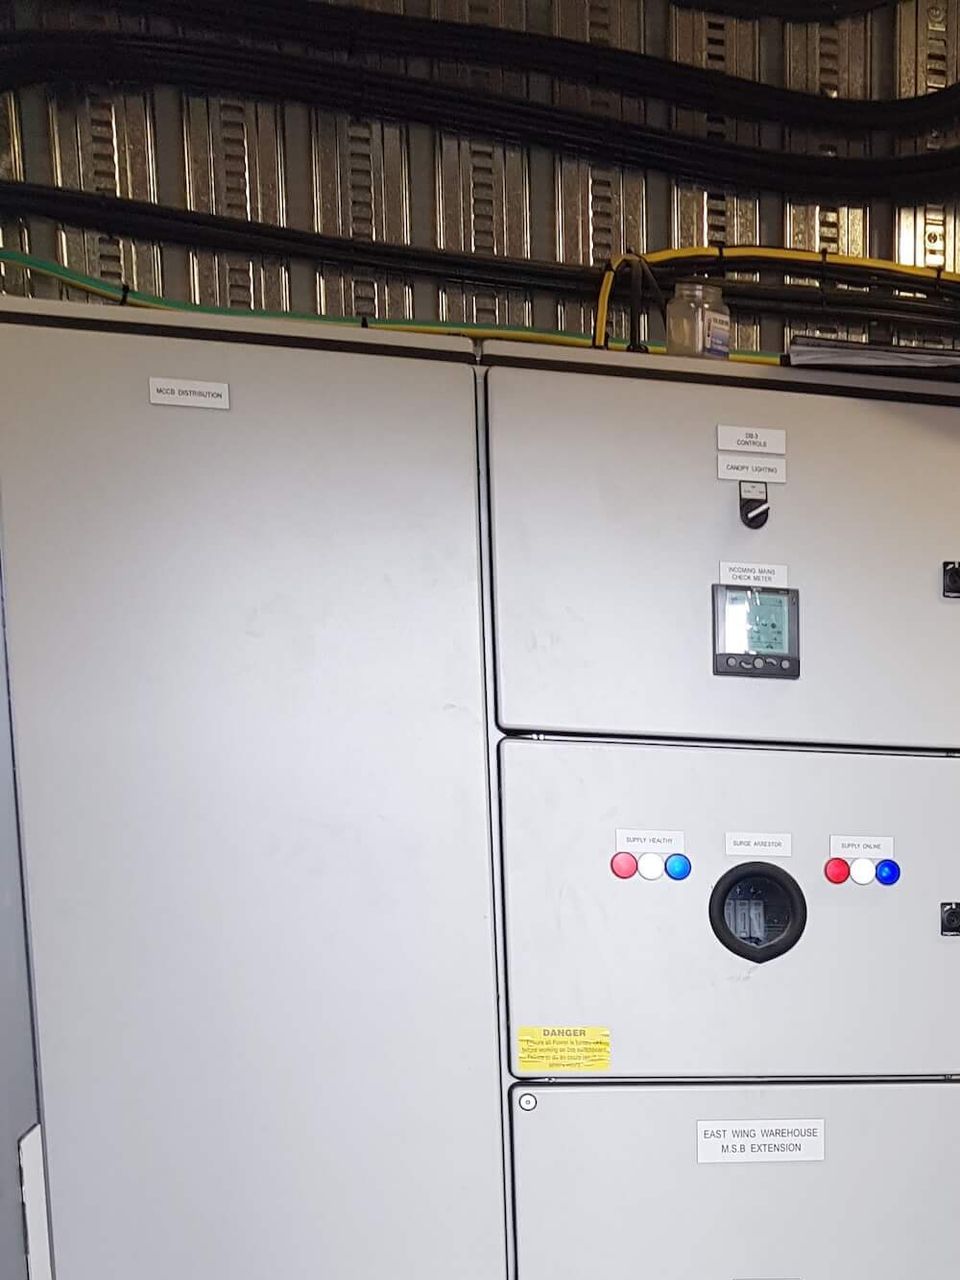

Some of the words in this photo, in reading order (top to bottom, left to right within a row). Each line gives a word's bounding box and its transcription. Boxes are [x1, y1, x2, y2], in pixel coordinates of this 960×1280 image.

[736, 439, 768, 447] CONTROLS
[726, 464, 749, 472] CANOPY
[728, 566, 756, 575] INCOMING
[543, 1028, 587, 1037] DANGER
[703, 1129, 727, 1139] EAST
[731, 1129, 757, 1139] WING
[760, 1128, 819, 1138] WAREHOUSE
[750, 1143, 803, 1153] EXTENSION
